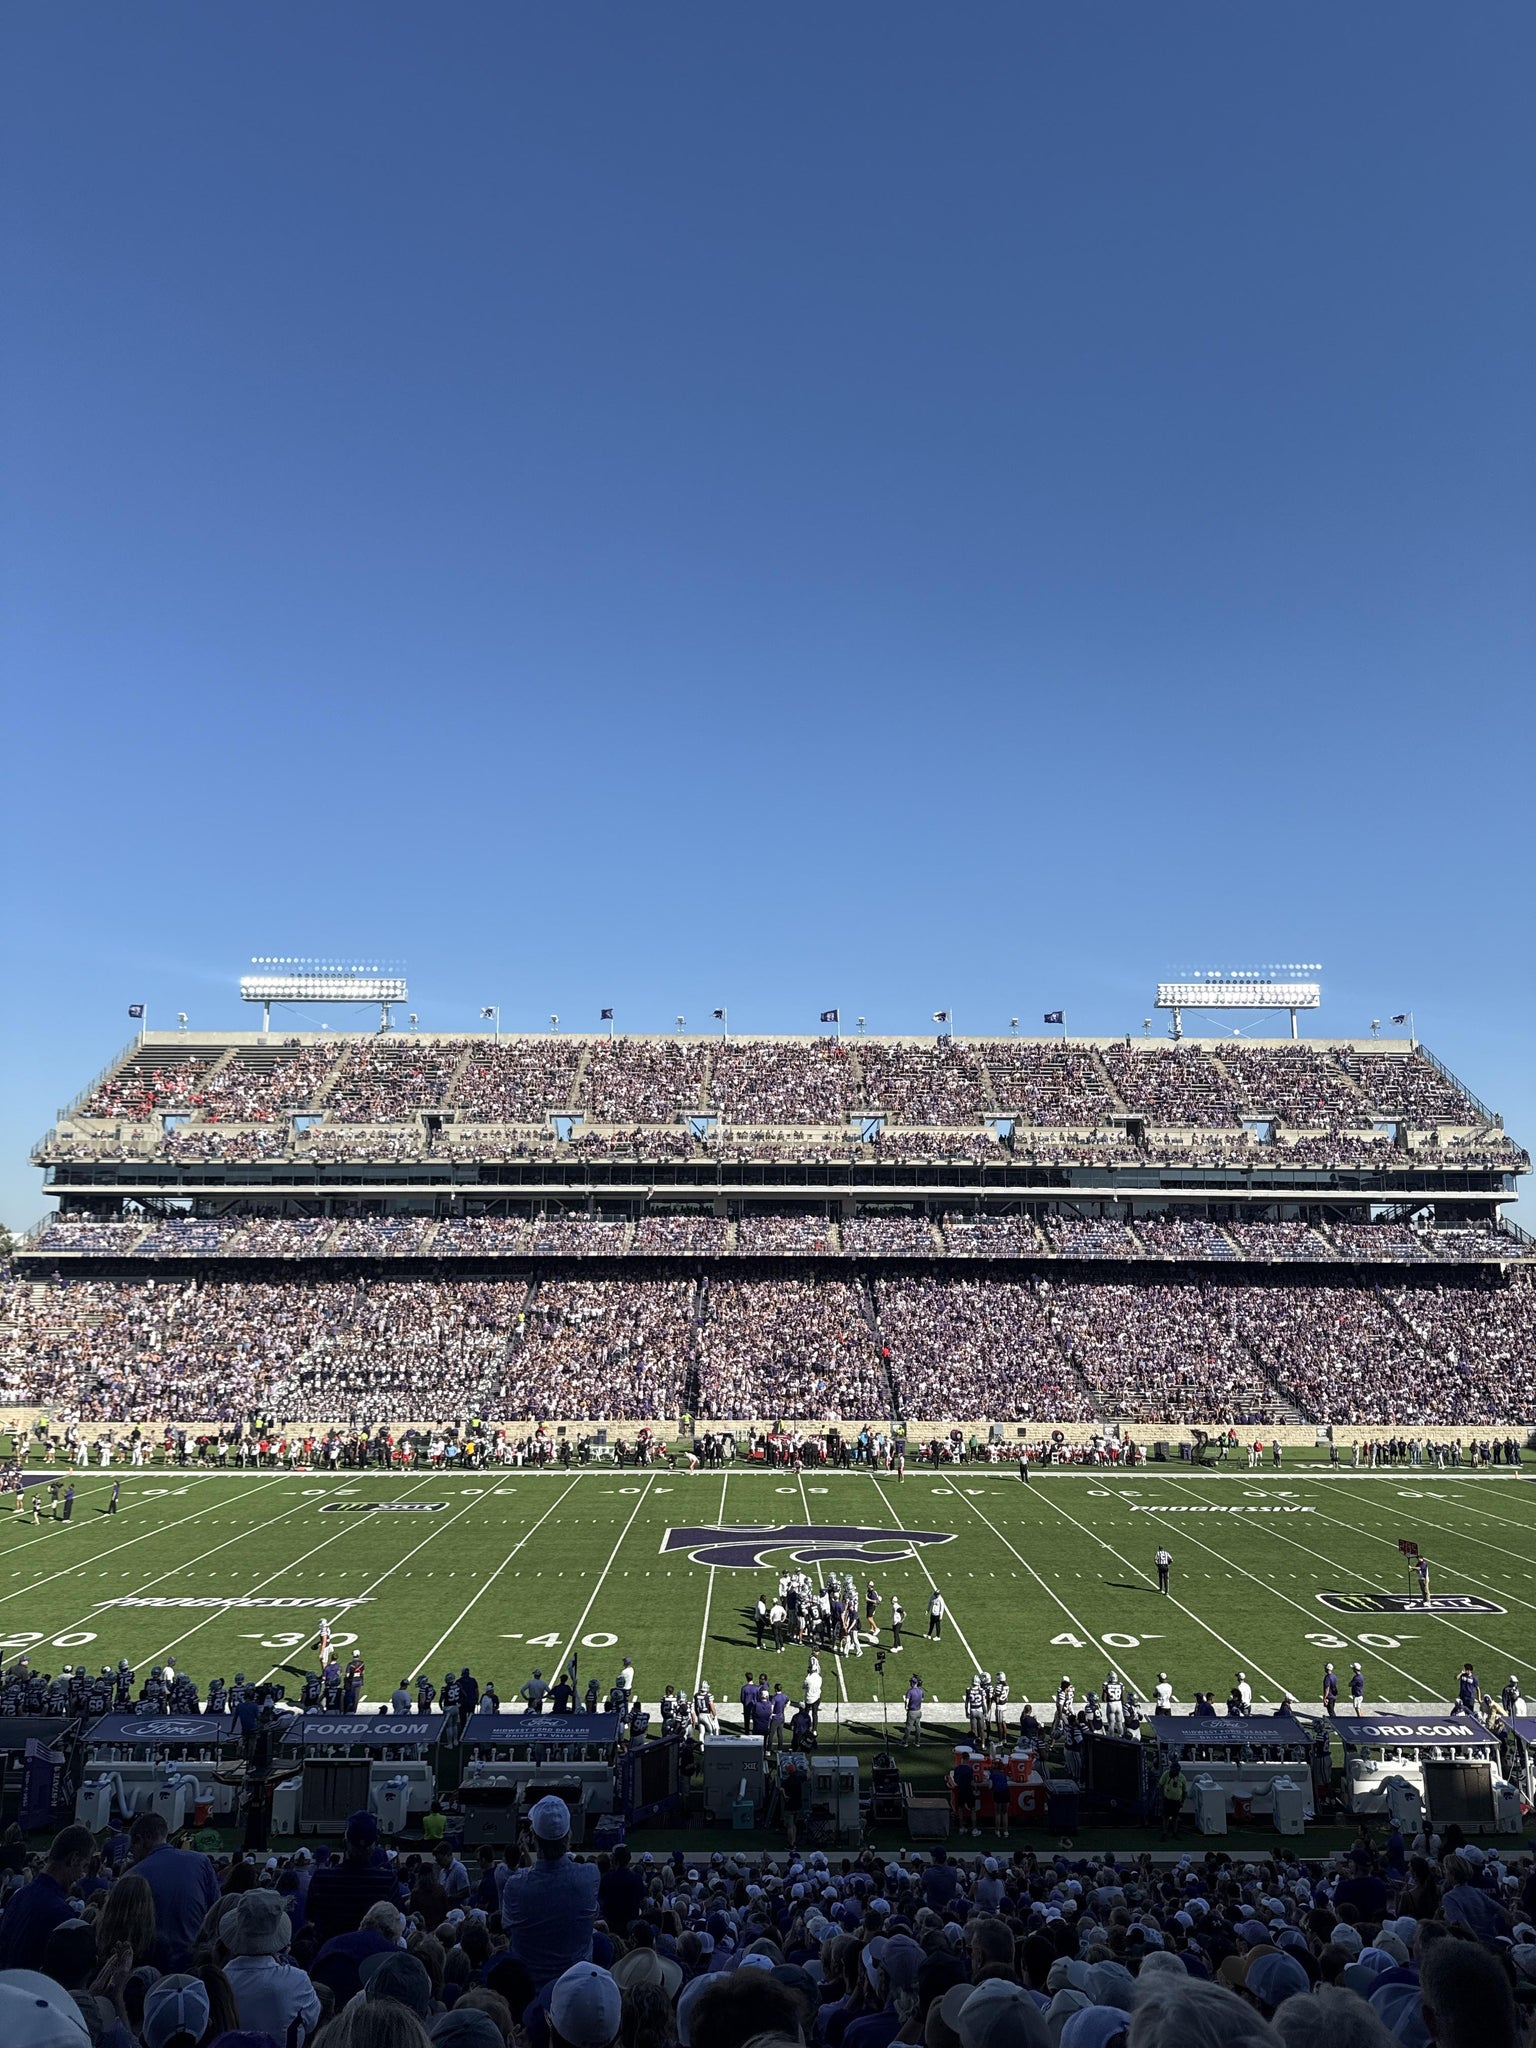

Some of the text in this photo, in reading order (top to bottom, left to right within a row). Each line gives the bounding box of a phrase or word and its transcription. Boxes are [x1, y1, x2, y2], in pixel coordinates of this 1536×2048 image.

[1129, 1505, 1317, 1513] PROGRESSIVE
[91, 1597, 378, 1607] PROGRESSIVE
[0, 1632, 98, 1647] 20
[260, 1632, 359, 1648] 30
[525, 1632, 619, 1648] 40
[1050, 1632, 1140, 1648] 40
[1304, 1633, 1401, 1648] 30
[136, 1721, 205, 1735] Ford
[303, 1723, 429, 1735] FORD.COM
[1348, 1725, 1474, 1736] FORD.COM
[1018, 1790, 1036, 1812] G
